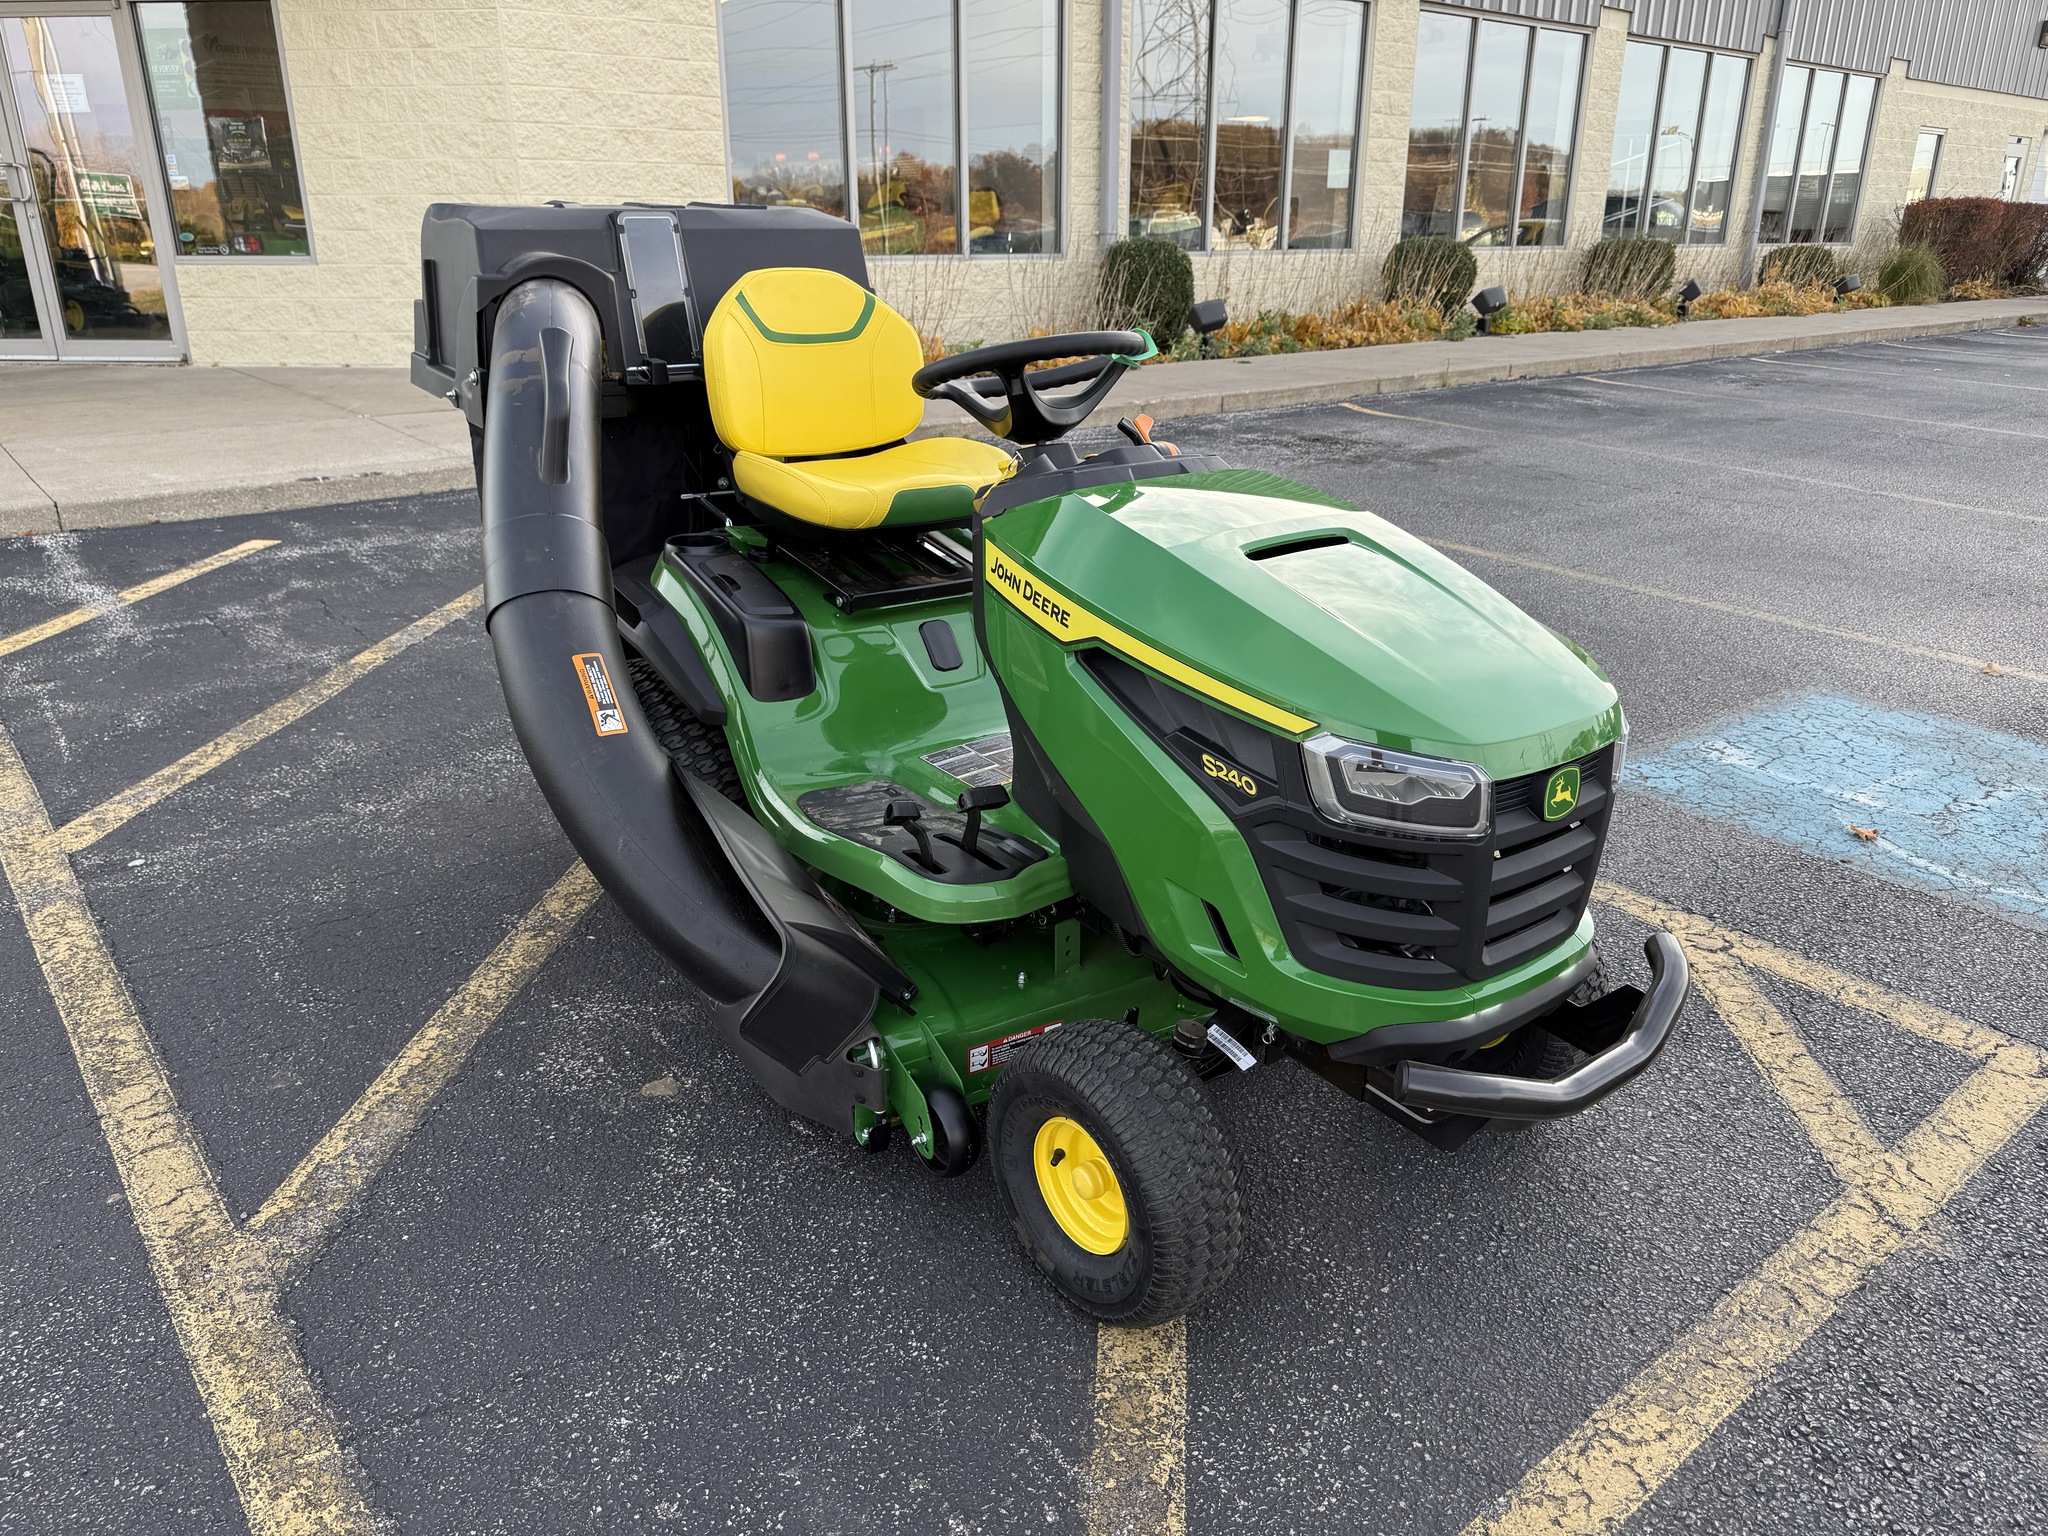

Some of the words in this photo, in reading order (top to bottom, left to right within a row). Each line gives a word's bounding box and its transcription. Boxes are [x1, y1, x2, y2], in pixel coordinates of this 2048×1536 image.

[990, 556, 1021, 594] JOHN
[1022, 579, 1071, 629] DEERE
[1201, 753, 1257, 796] S240
[1008, 1030, 1032, 1042] DANGER
